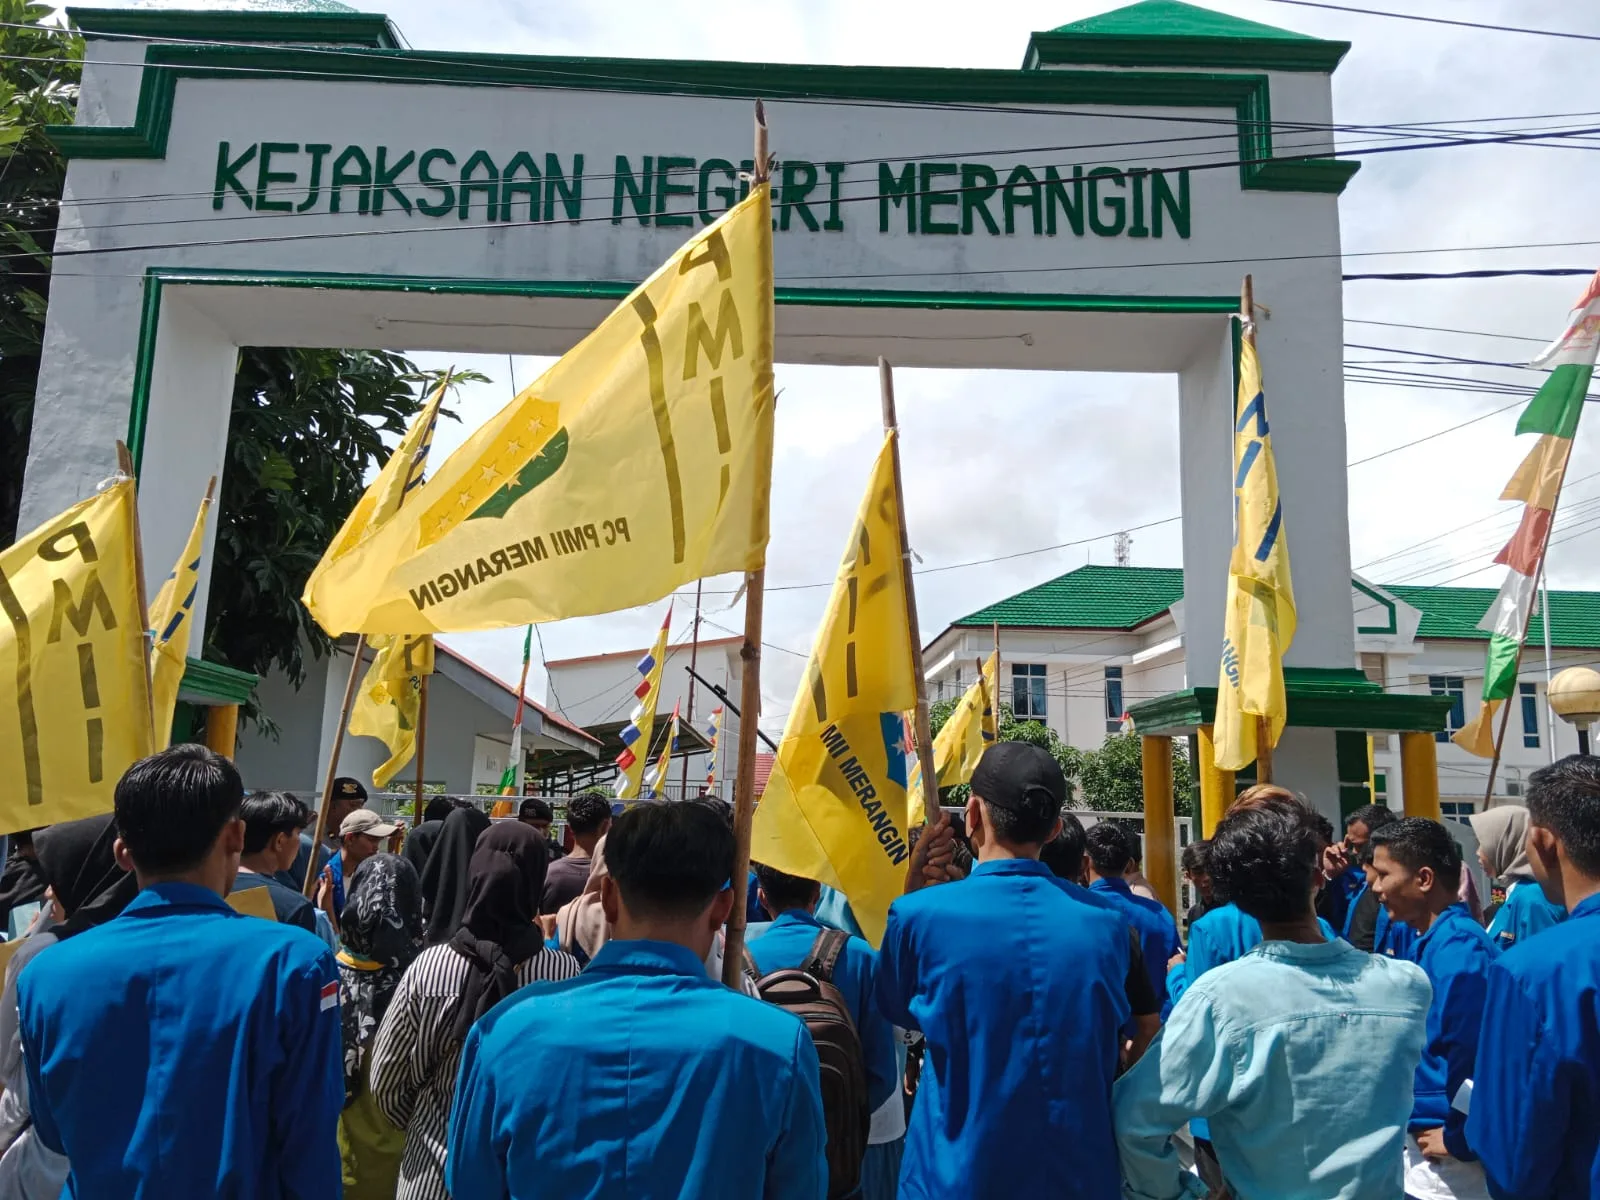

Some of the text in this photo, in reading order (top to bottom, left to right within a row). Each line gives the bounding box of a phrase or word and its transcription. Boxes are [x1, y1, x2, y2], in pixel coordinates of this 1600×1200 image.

[212, 141, 584, 224] KEJAKSAAN
[878, 161, 1191, 240] MERANGIN
[838, 755, 909, 866] MERANGIN
